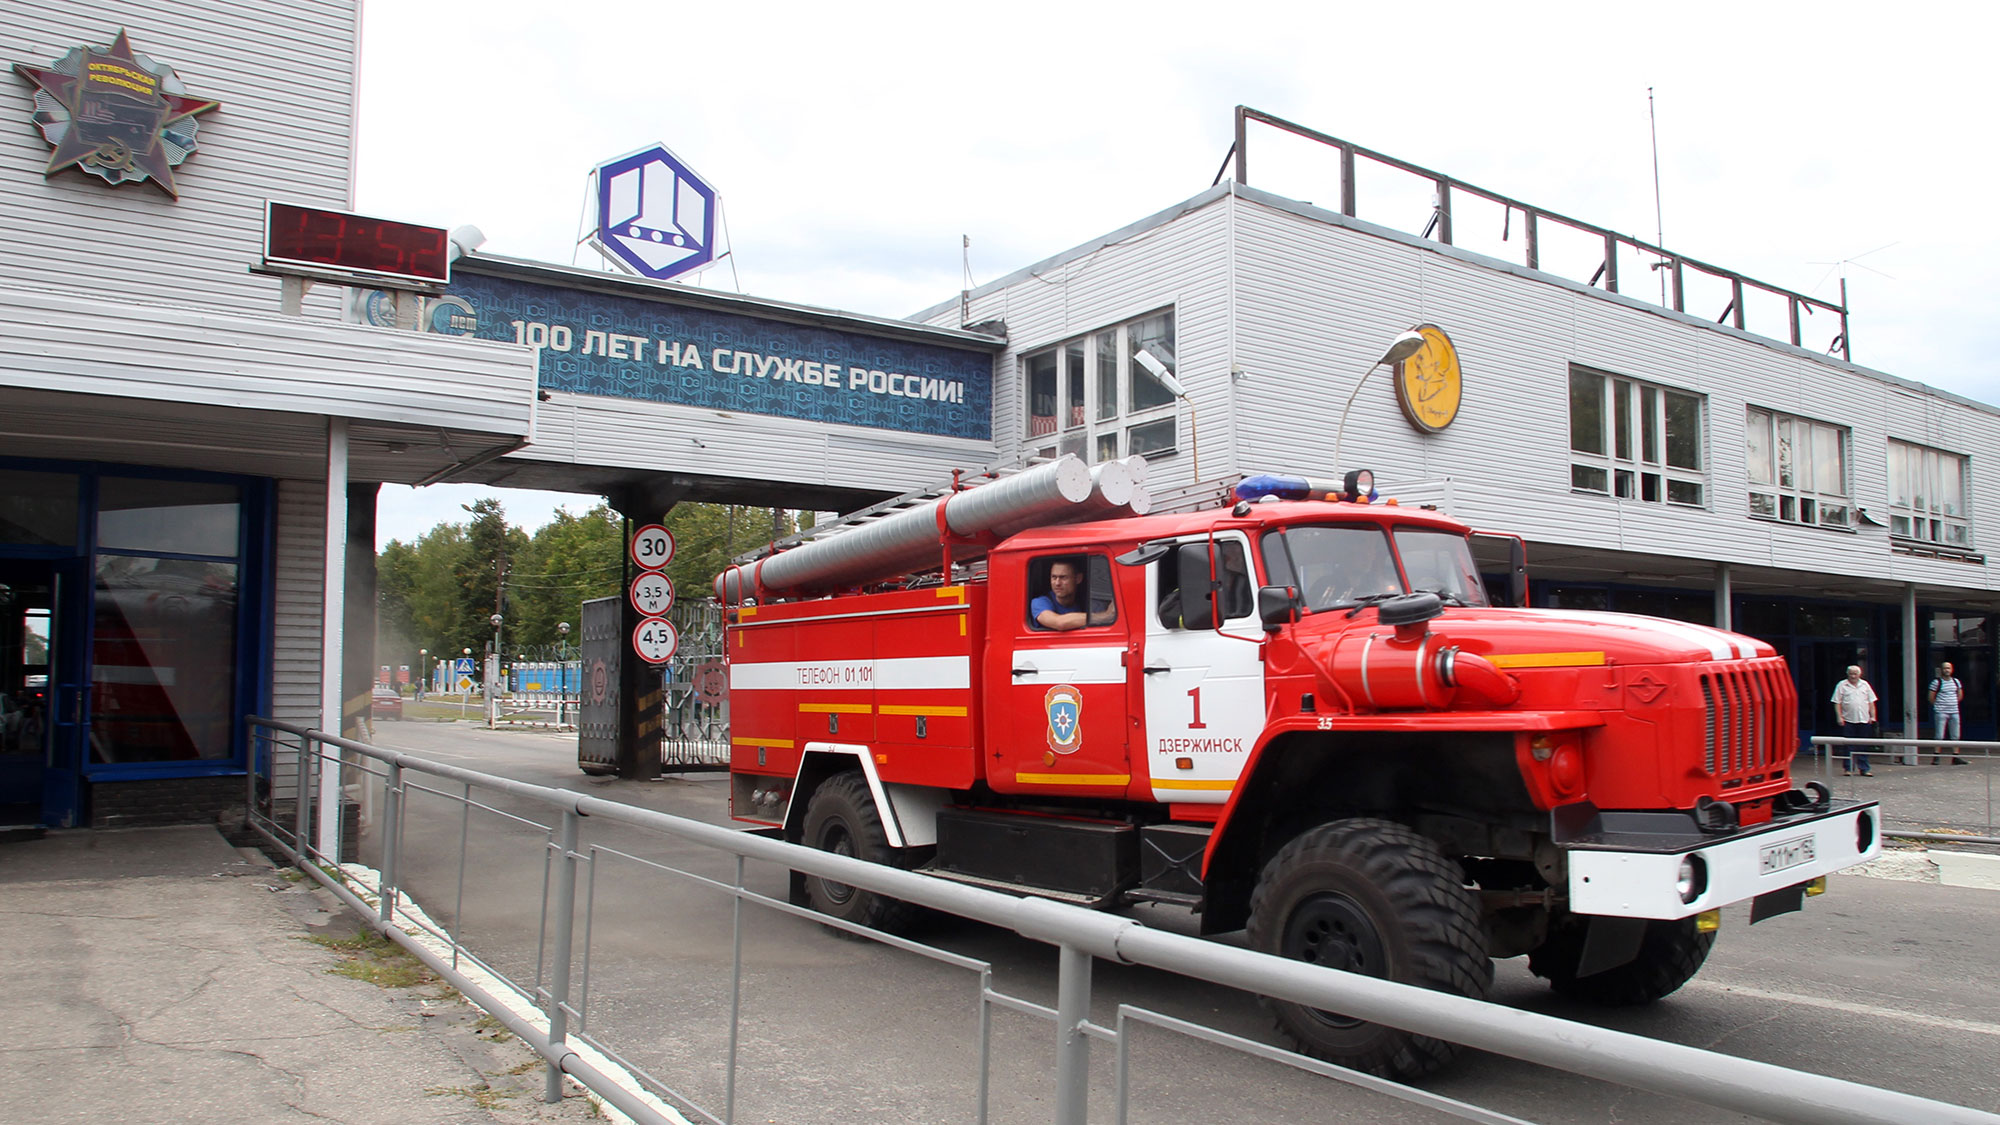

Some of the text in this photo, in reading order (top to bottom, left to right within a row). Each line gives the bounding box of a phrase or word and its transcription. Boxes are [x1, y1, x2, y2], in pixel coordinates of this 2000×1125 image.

[88, 63, 155, 86] ОКТЯБРЬСКАЯ
[89, 74, 152, 95] РЕВОЛЮЦИЯ
[512, 320, 964, 403] 100 ЛЕТ НА СЛУЖБЕ РОССИИ!
[641, 538, 666, 556] 30
[797, 667, 840, 684] ТЕЛЕФОН
[1187, 686, 1206, 729] 1
[1159, 738, 1243, 754] ДЗЕРЖИНСК
